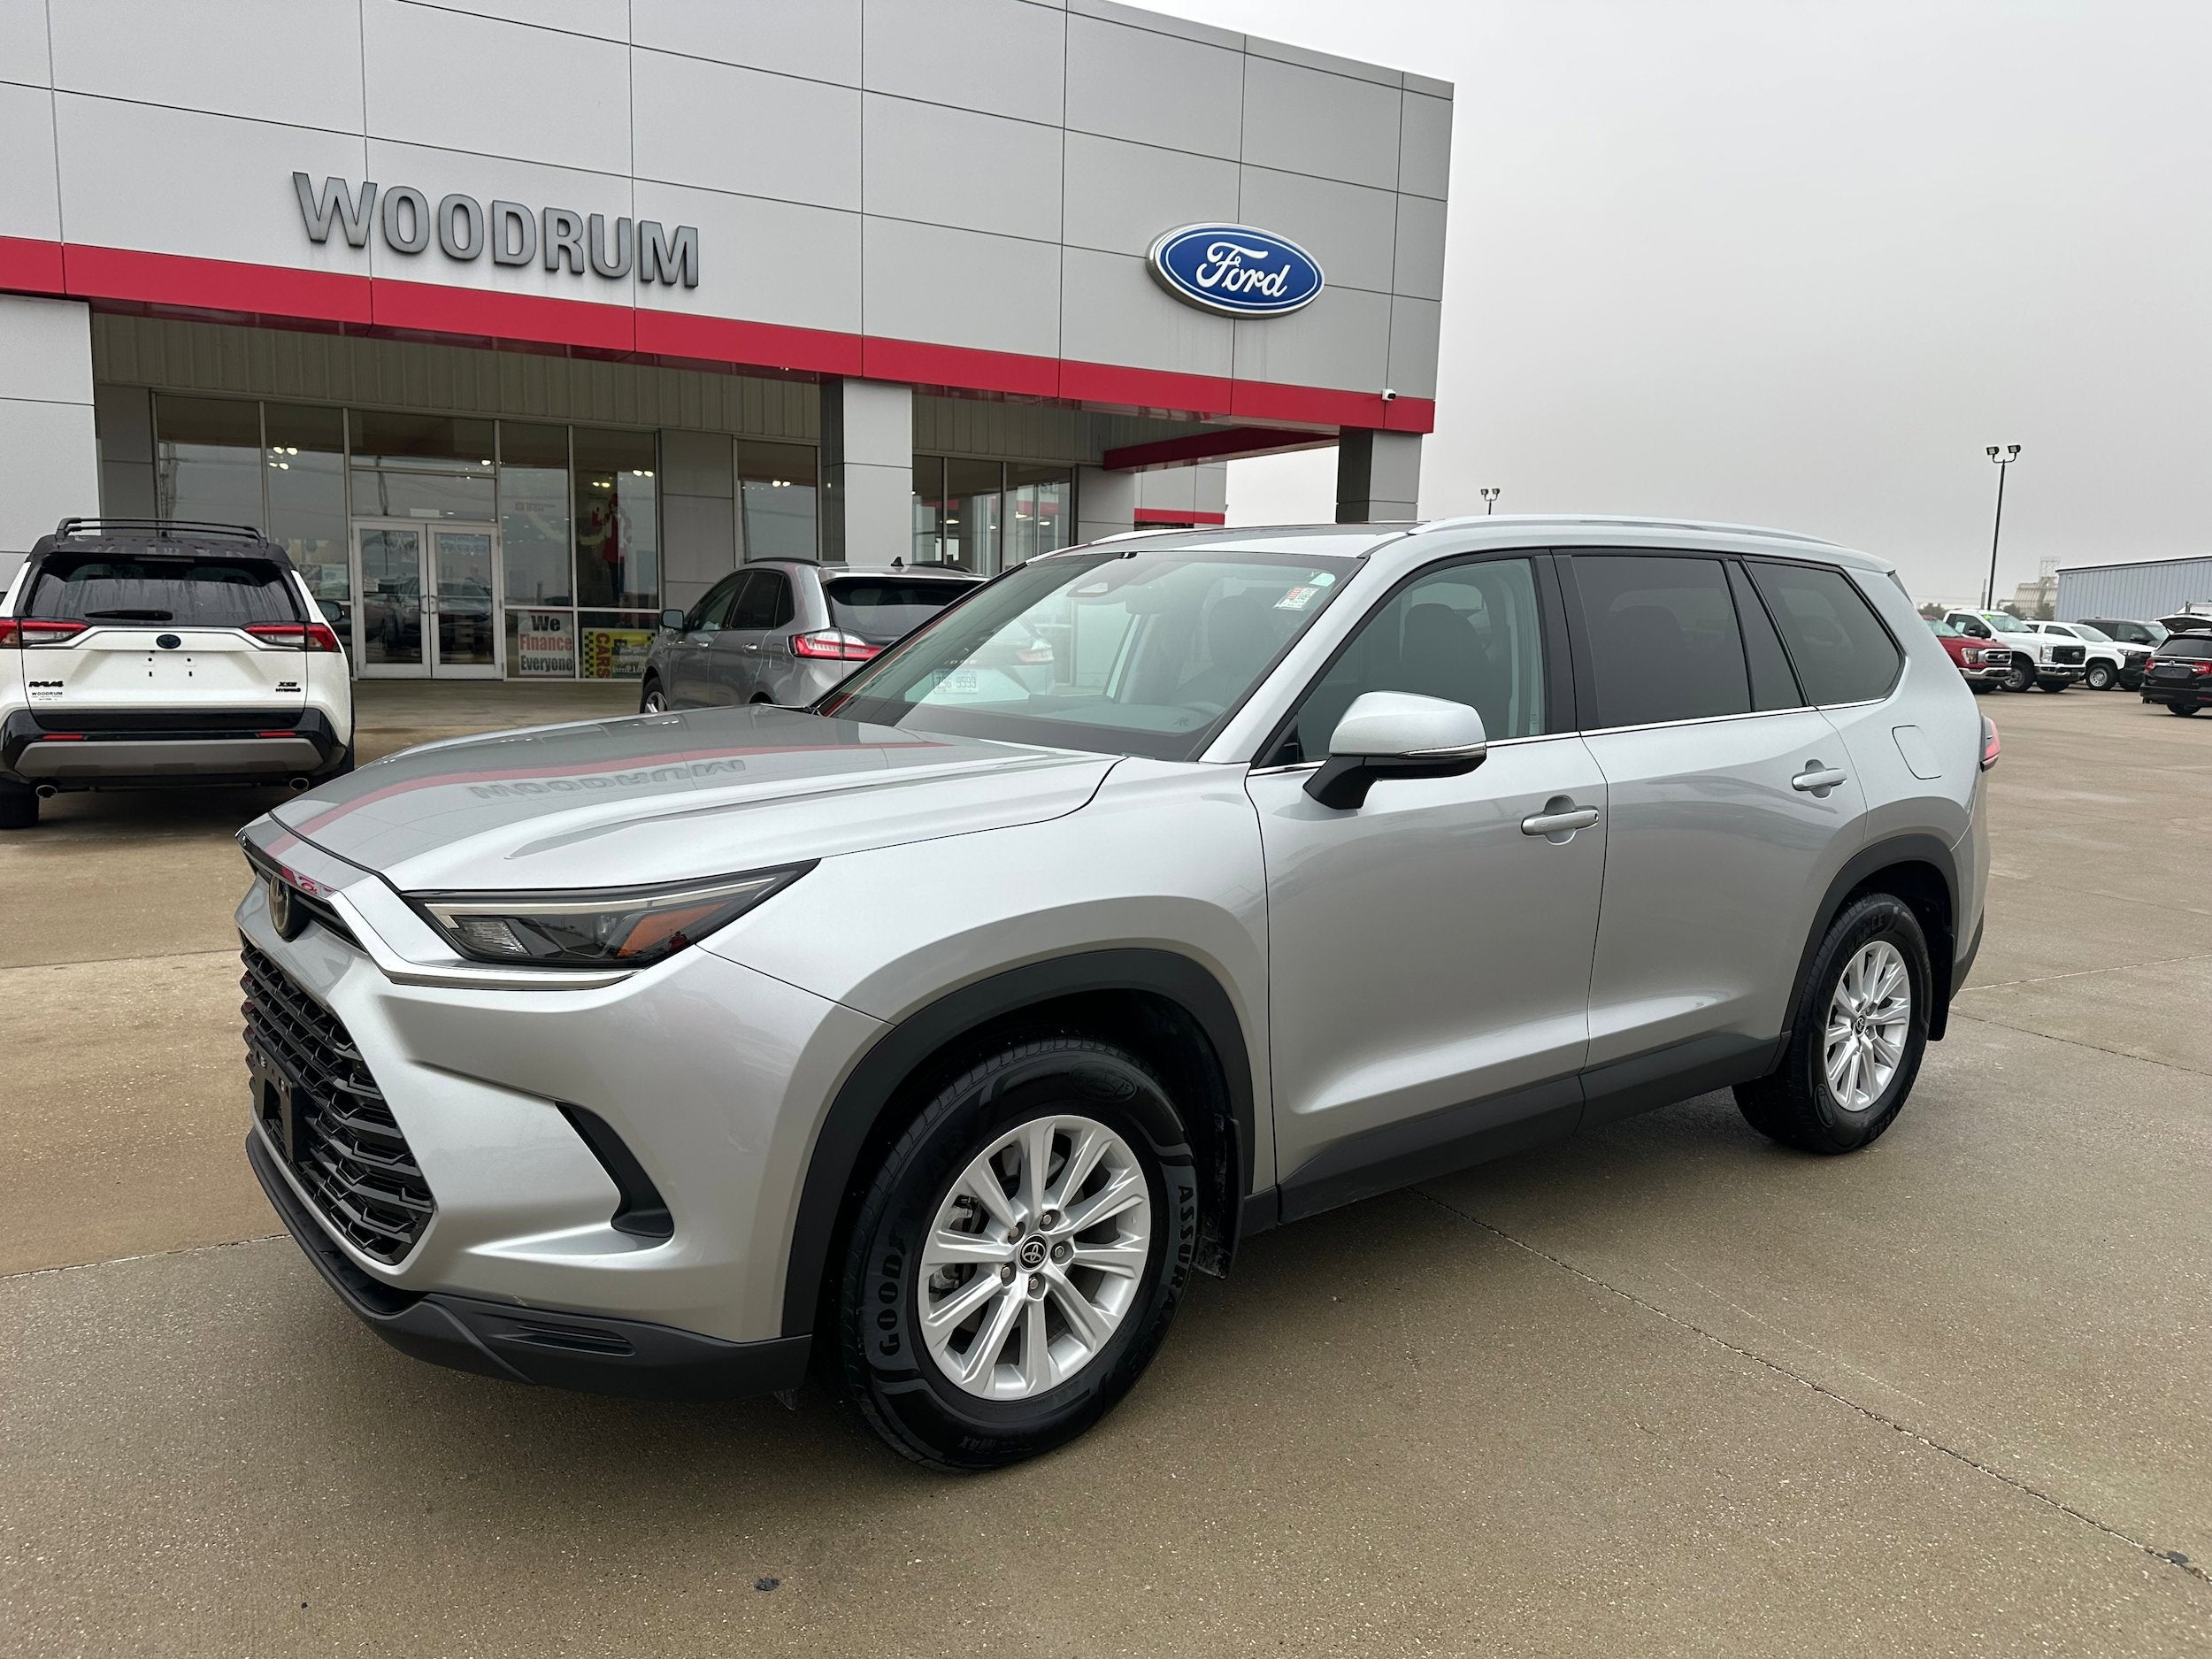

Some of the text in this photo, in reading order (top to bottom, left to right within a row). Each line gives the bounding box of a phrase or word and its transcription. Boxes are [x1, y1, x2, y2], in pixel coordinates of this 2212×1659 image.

[293, 172, 699, 288] WOODRUM
[1196, 242, 1291, 298] Ford
[531, 615, 561, 632] We
[518, 634, 573, 651] Finance
[595, 633, 611, 678] CARS
[520, 655, 573, 672] Everyone
